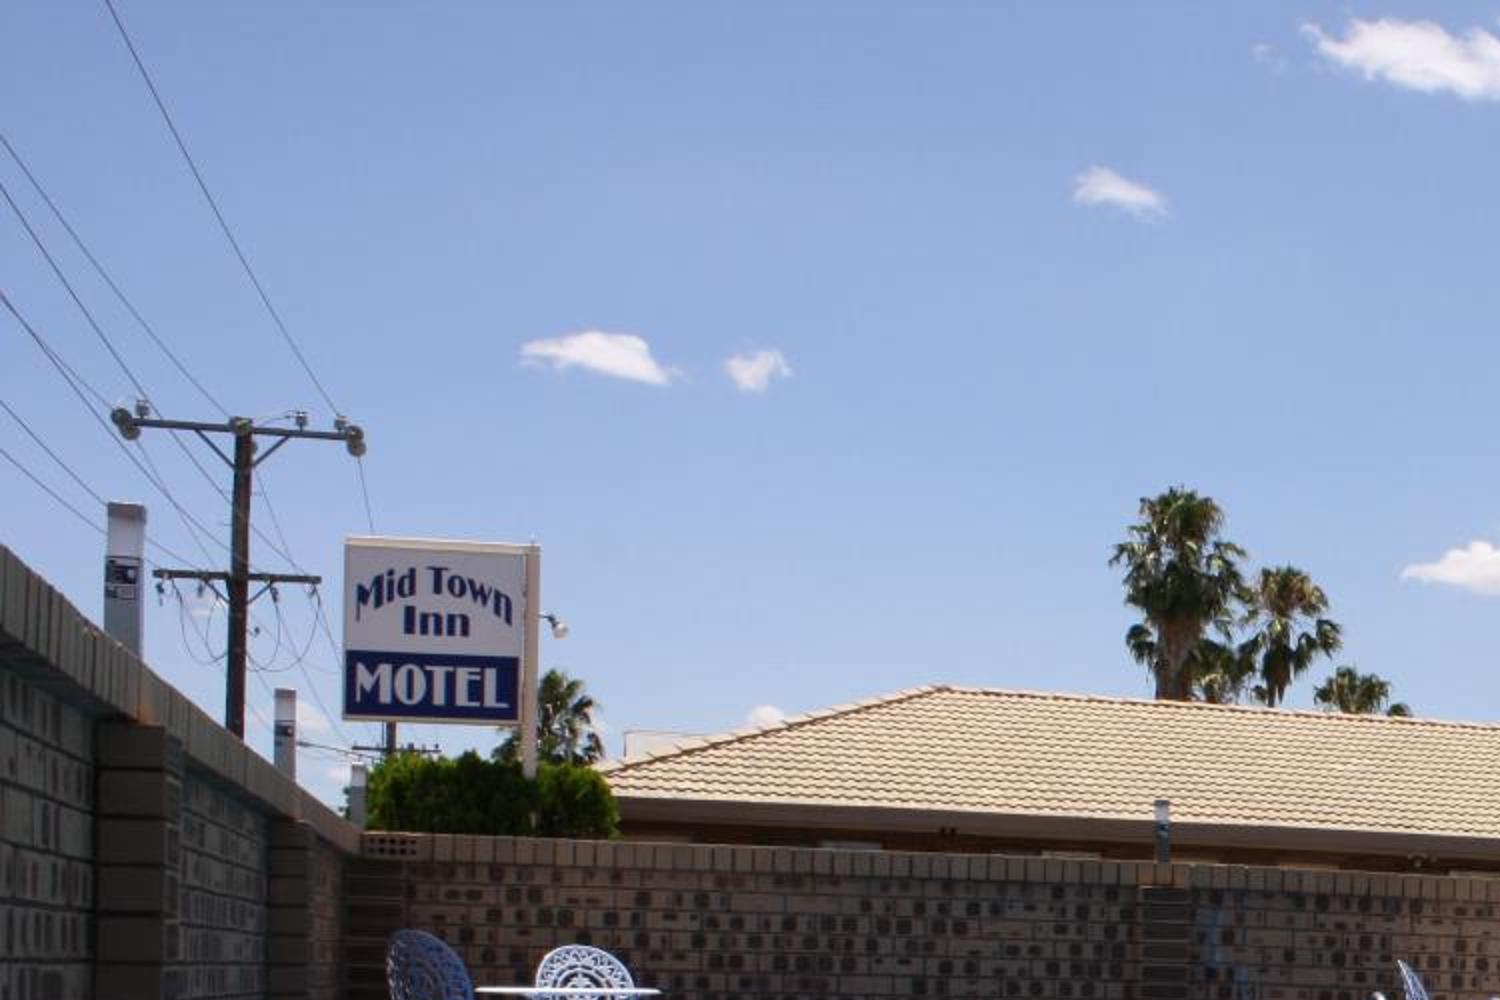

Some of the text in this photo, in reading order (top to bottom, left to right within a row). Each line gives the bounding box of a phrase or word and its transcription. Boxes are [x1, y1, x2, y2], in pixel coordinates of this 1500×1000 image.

[356, 565, 512, 626] Mid Town
[403, 605, 470, 637] Inn
[355, 661, 509, 708] MOTEL
